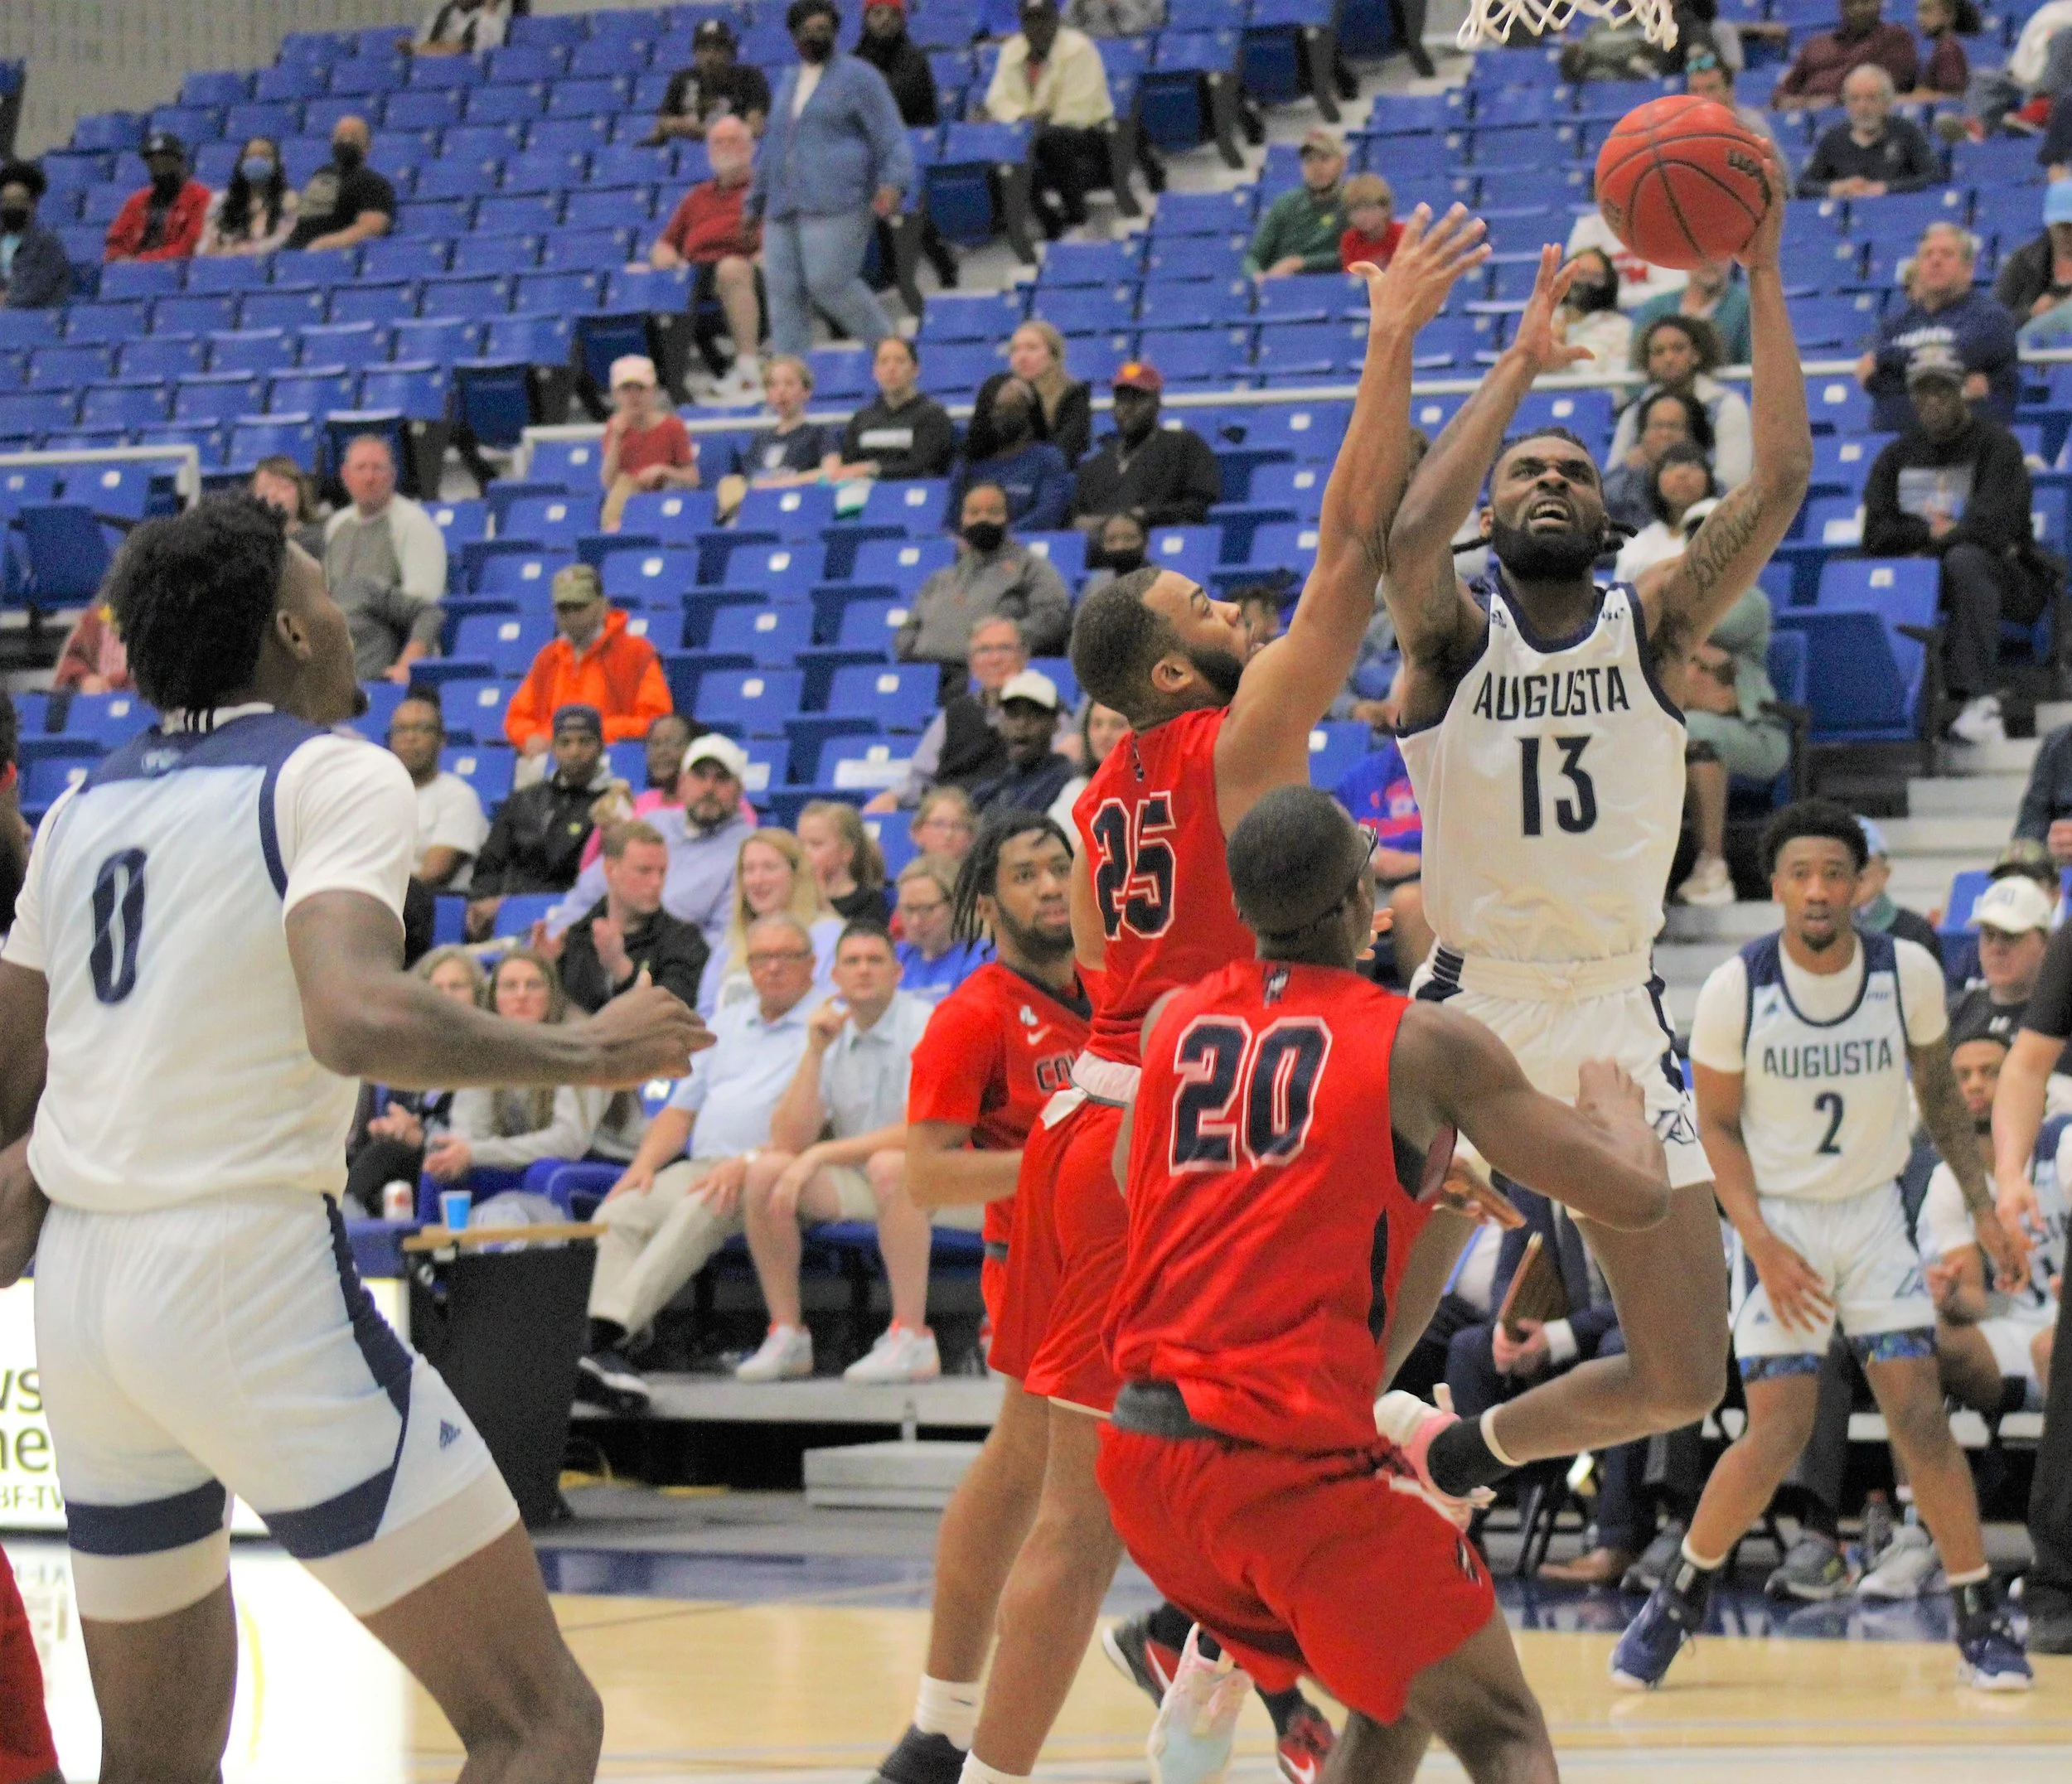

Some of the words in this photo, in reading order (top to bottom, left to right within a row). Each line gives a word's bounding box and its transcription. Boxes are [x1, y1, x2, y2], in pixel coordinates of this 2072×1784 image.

[1473, 665, 1630, 721] AUGUSTA
[1516, 733, 1598, 838] 13
[1091, 790, 1177, 941] 25
[89, 846, 149, 1006] 0
[1169, 1015, 1333, 1177] 20
[1762, 1037, 1893, 1079] AUGUSTA
[1813, 1091, 1845, 1156] 2
